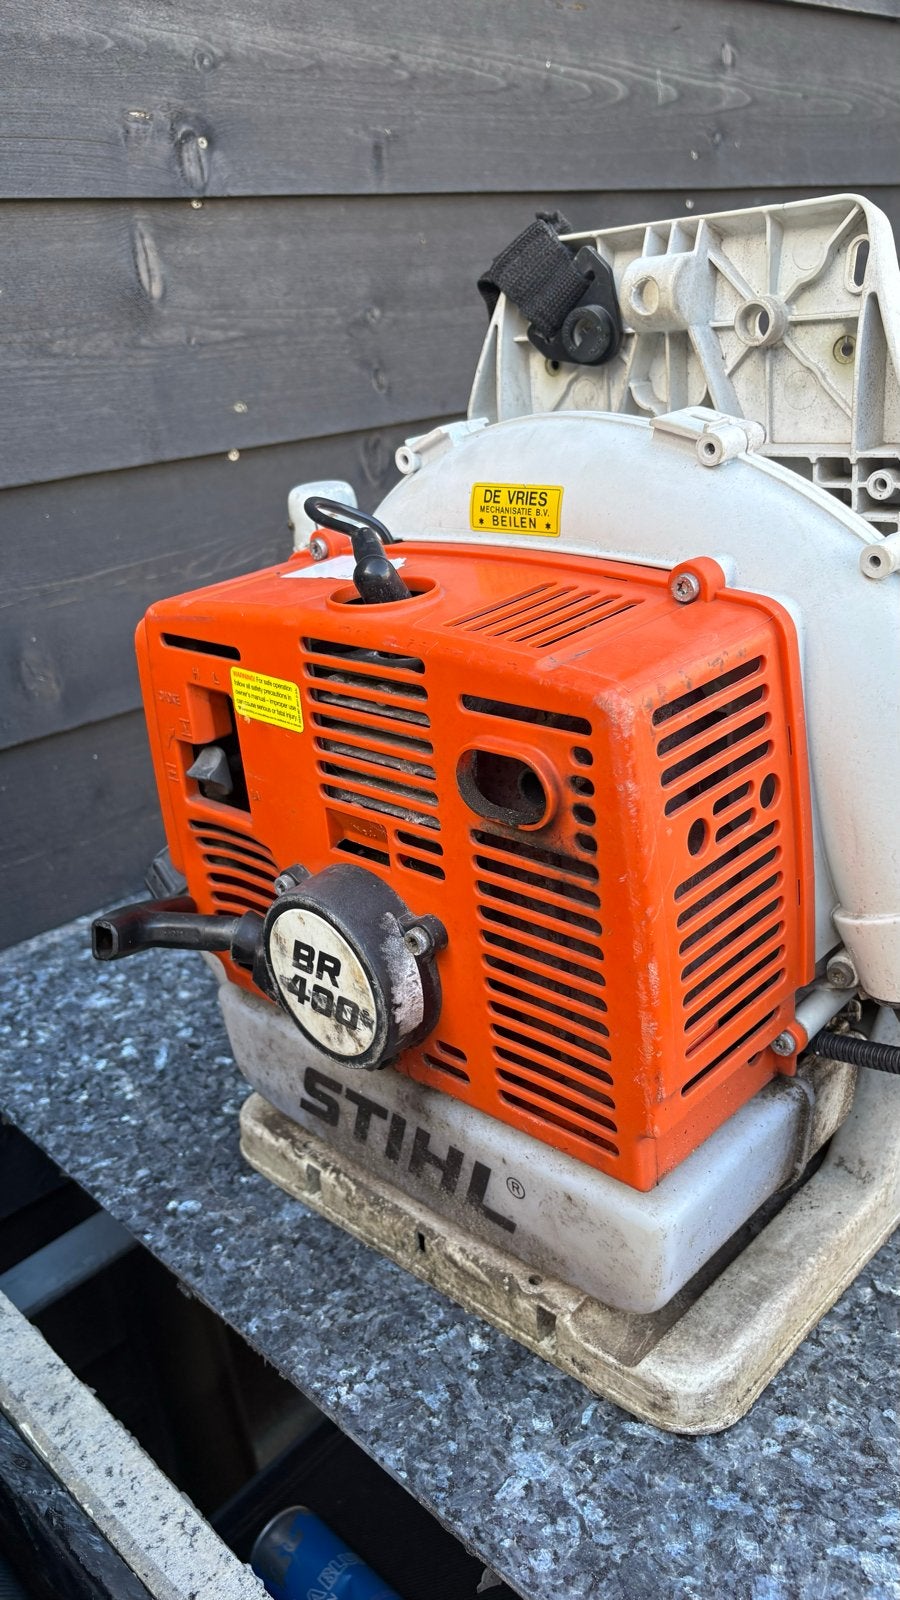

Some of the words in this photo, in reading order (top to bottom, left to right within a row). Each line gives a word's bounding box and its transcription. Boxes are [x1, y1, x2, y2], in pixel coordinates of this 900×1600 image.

[480, 506, 532, 515] MECHANISATIE
[536, 509, 550, 517] B.V.
[484, 489, 501, 503] DE
[508, 490, 547, 506] VRIES
[492, 515, 536, 528] BEILEN
[292, 939, 341, 988] BR
[287, 974, 360, 1030] 400
[299, 1066, 517, 1234] STIHL
